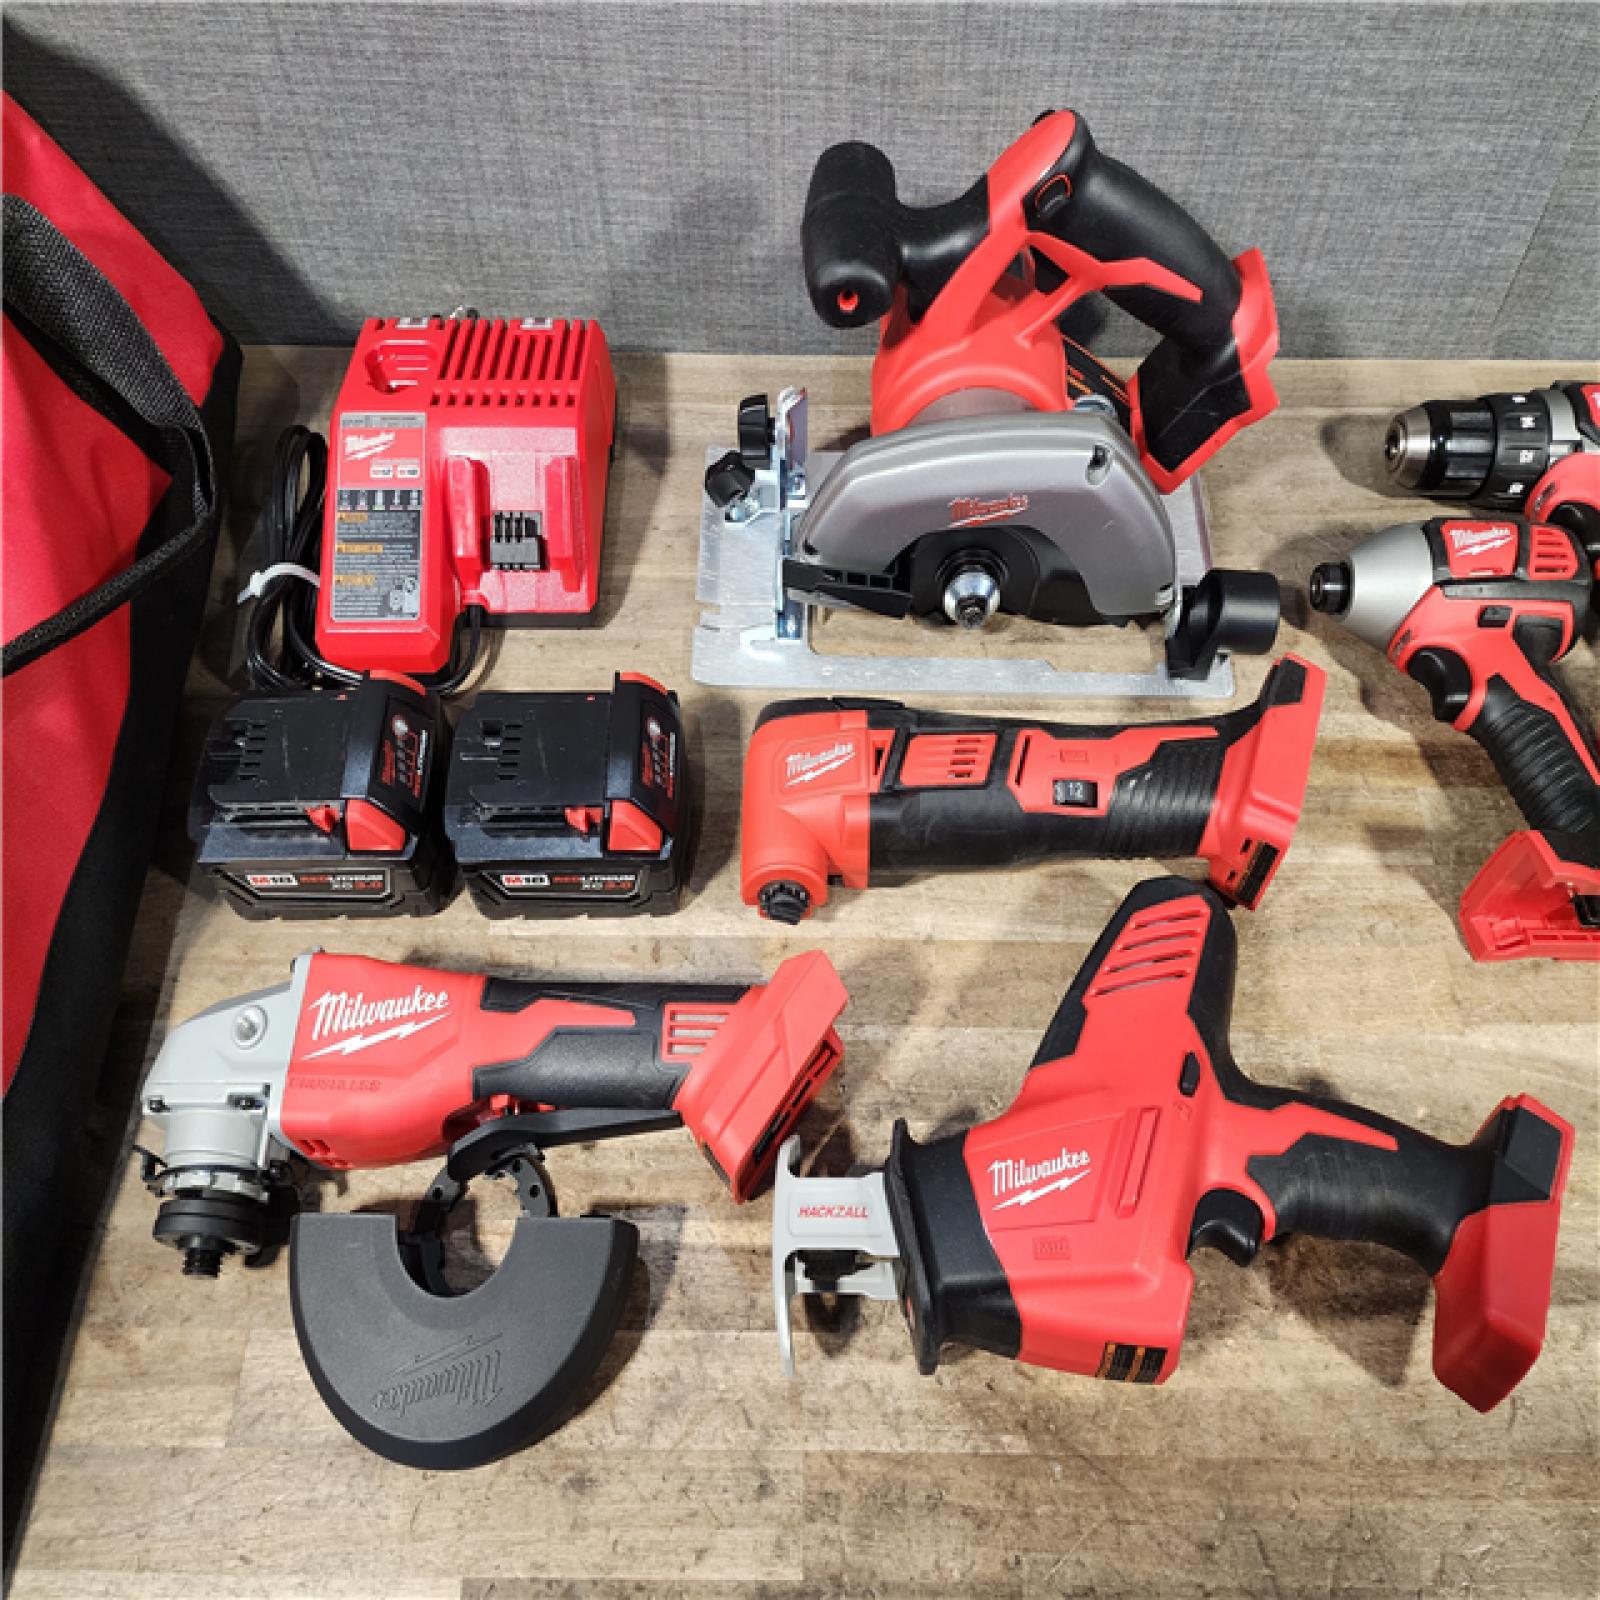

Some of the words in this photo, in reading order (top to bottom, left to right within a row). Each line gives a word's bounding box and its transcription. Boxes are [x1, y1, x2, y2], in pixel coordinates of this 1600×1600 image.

[947, 493, 1029, 520] Milwaukee
[1449, 525, 1511, 549] Milwaukee
[784, 743, 854, 778] Milwaukee
[308, 984, 450, 1041] Milwaukee
[987, 1147, 1091, 1197] Milwaukee
